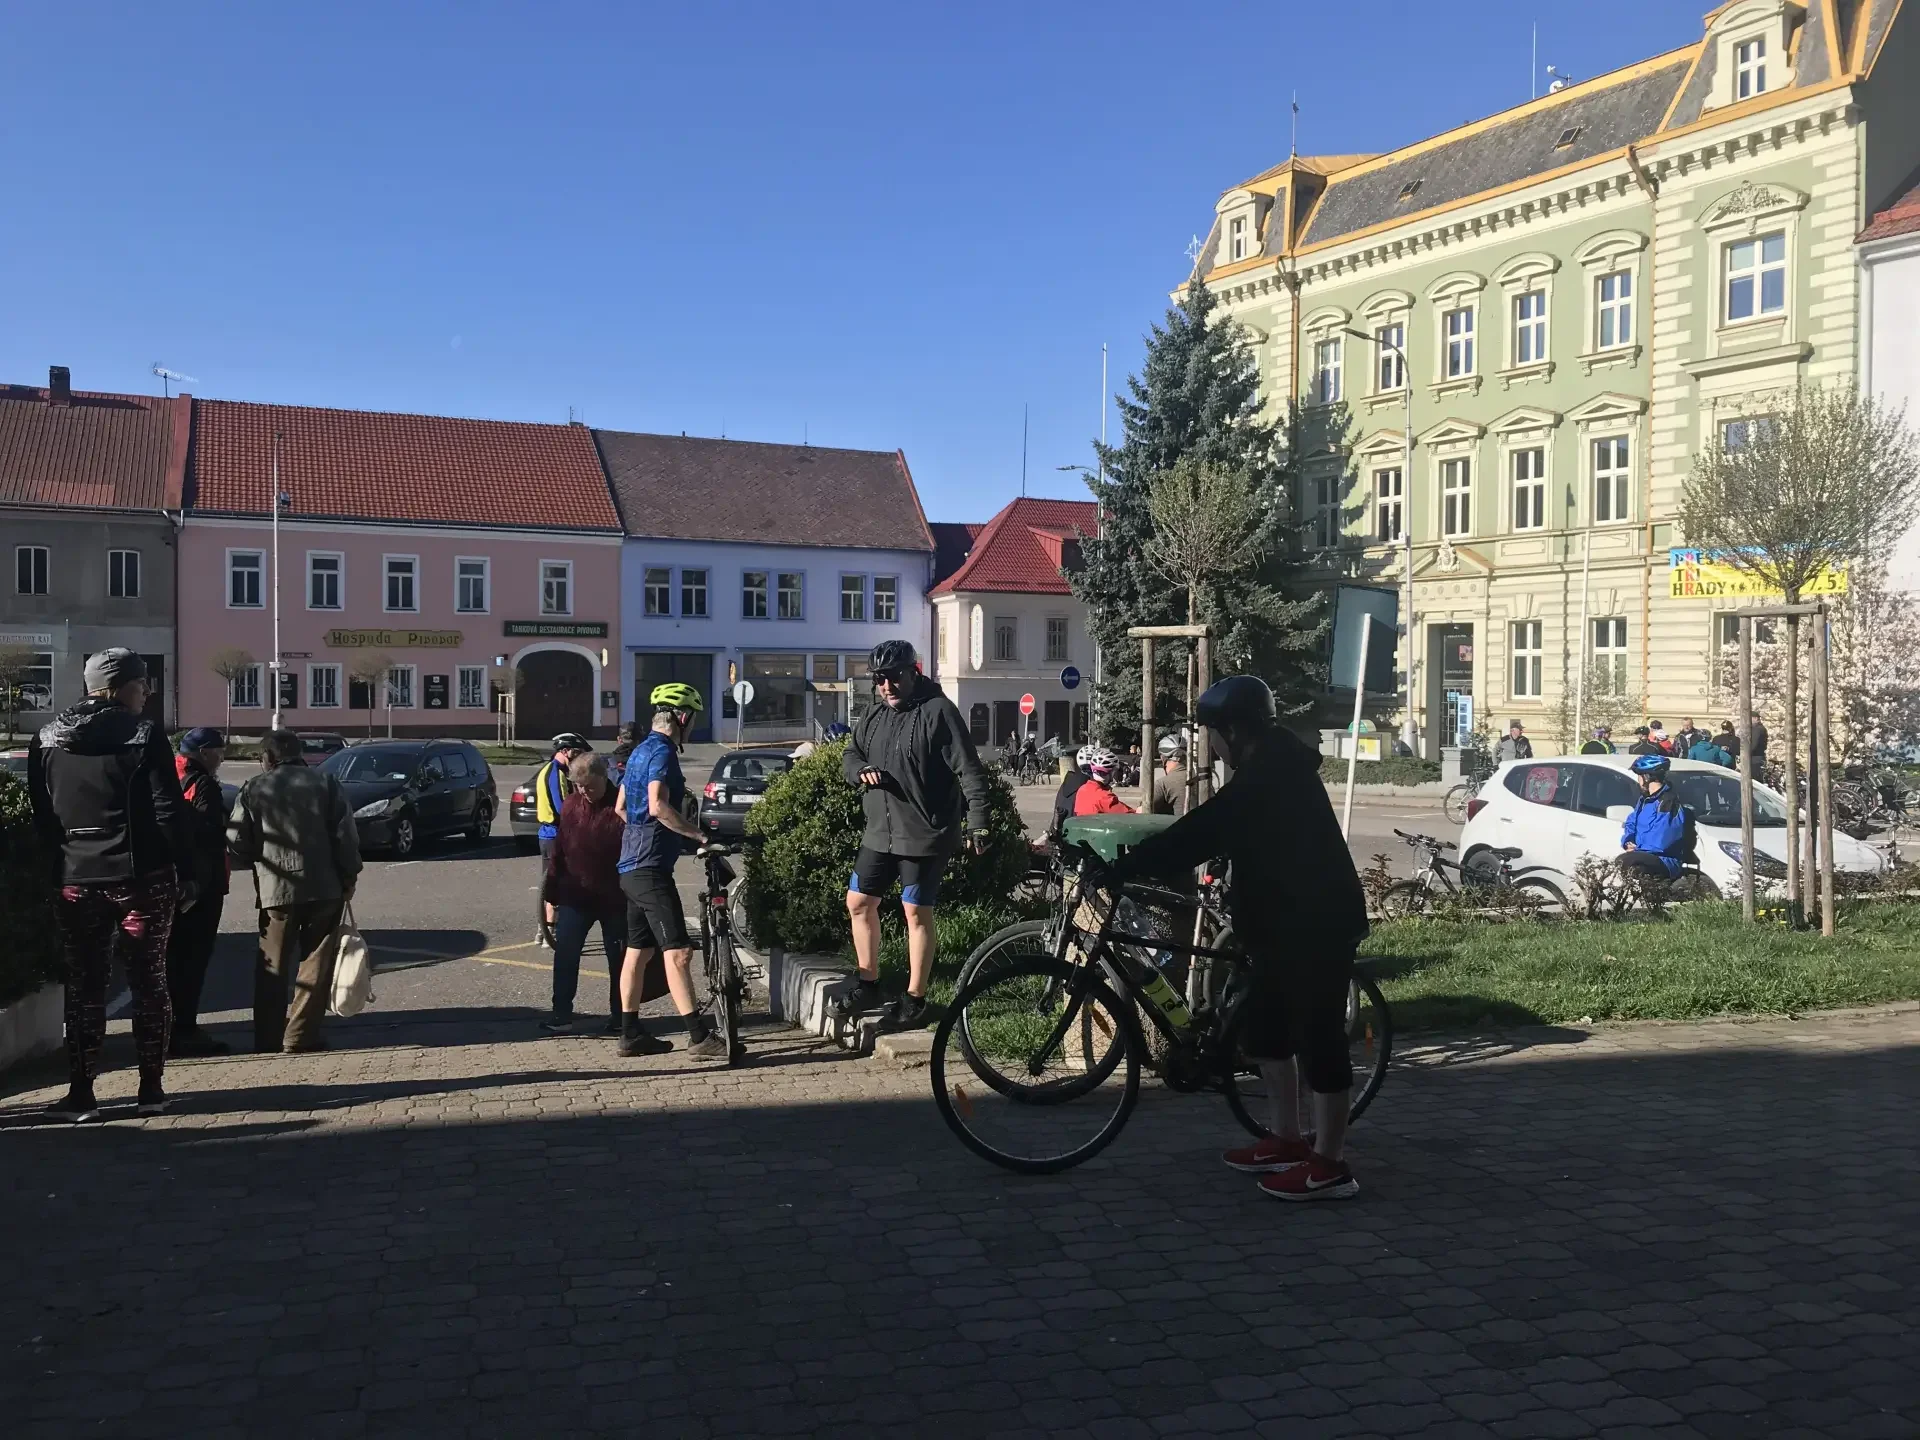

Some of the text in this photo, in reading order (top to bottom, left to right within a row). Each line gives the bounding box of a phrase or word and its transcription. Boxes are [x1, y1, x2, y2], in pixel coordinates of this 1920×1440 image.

[1673, 582, 1726, 596] HRADY
[539, 625, 575, 634] RESTAURACE
[576, 626, 601, 635] PIVOVAR
